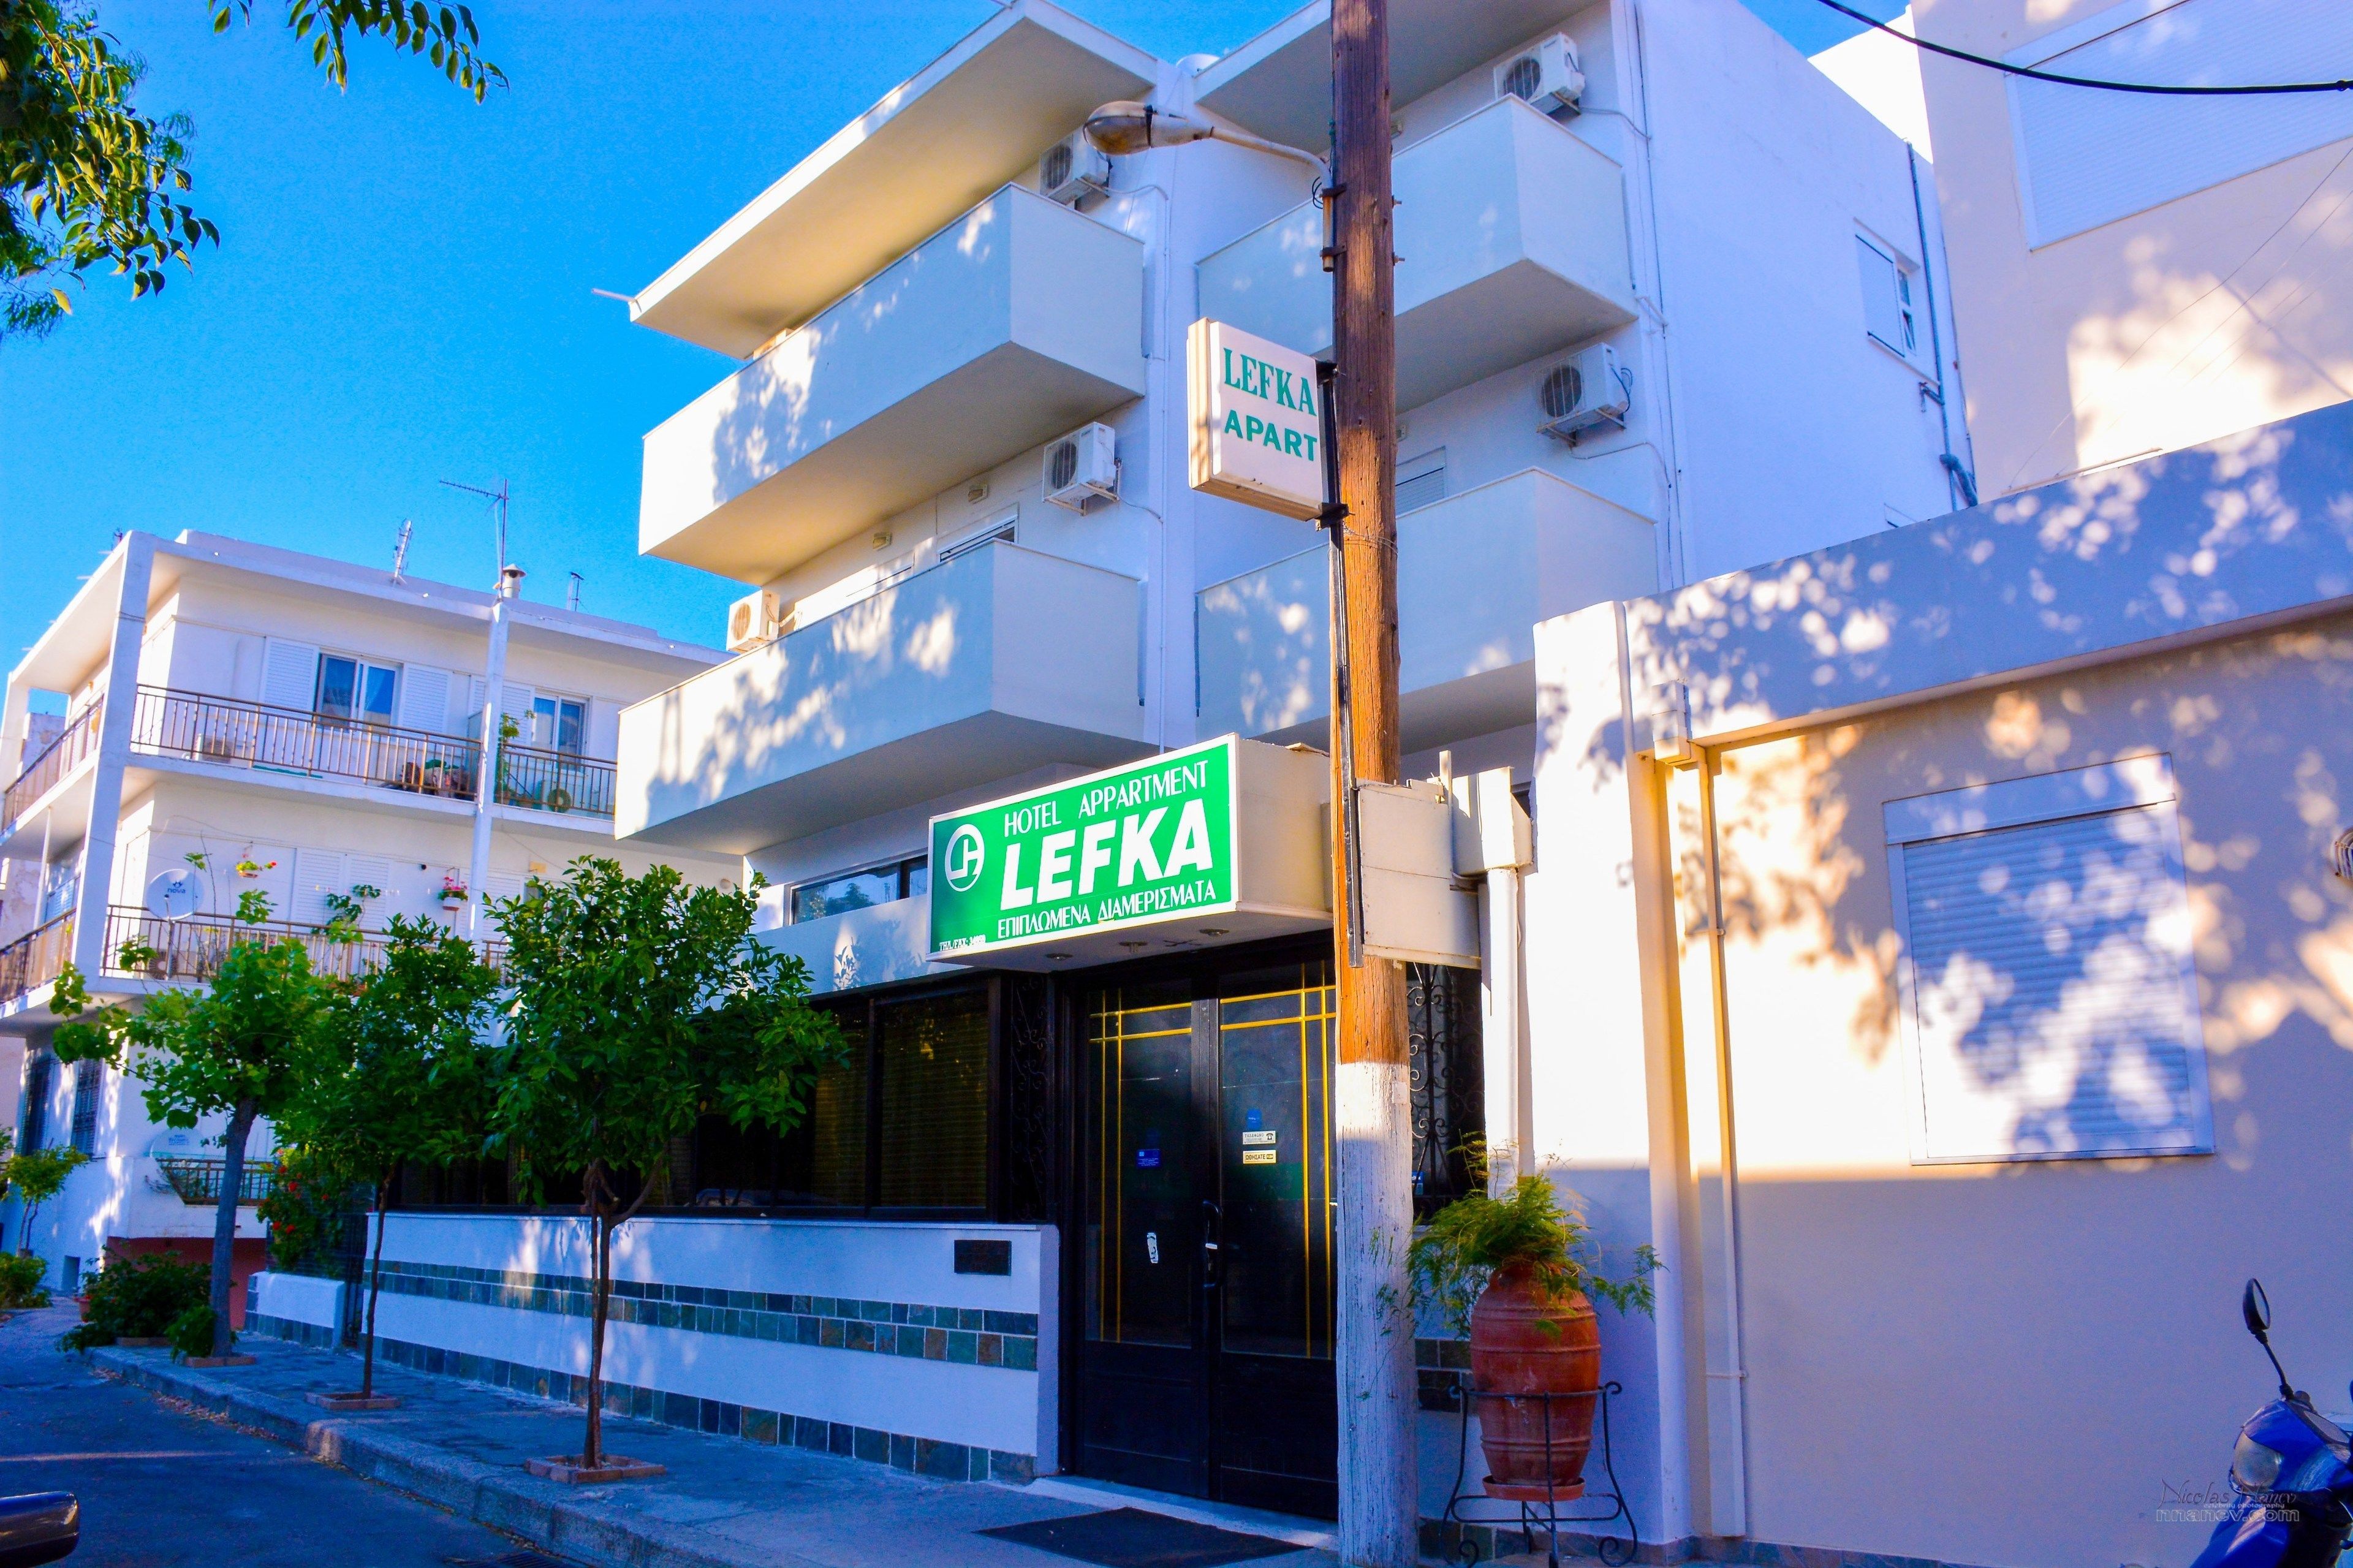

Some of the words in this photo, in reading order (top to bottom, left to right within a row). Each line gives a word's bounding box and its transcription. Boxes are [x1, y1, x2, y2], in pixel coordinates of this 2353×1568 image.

[1223, 347, 1317, 416] LEFKA
[1224, 409, 1317, 461] APART
[1004, 800, 1062, 838] HOTEL
[1078, 760, 1209, 819] APPARTMENT
[1000, 798, 1214, 911] LEFKA
[1097, 879, 1216, 920] ΔΙΑΜΕΡΙΣΜΑΤΑ
